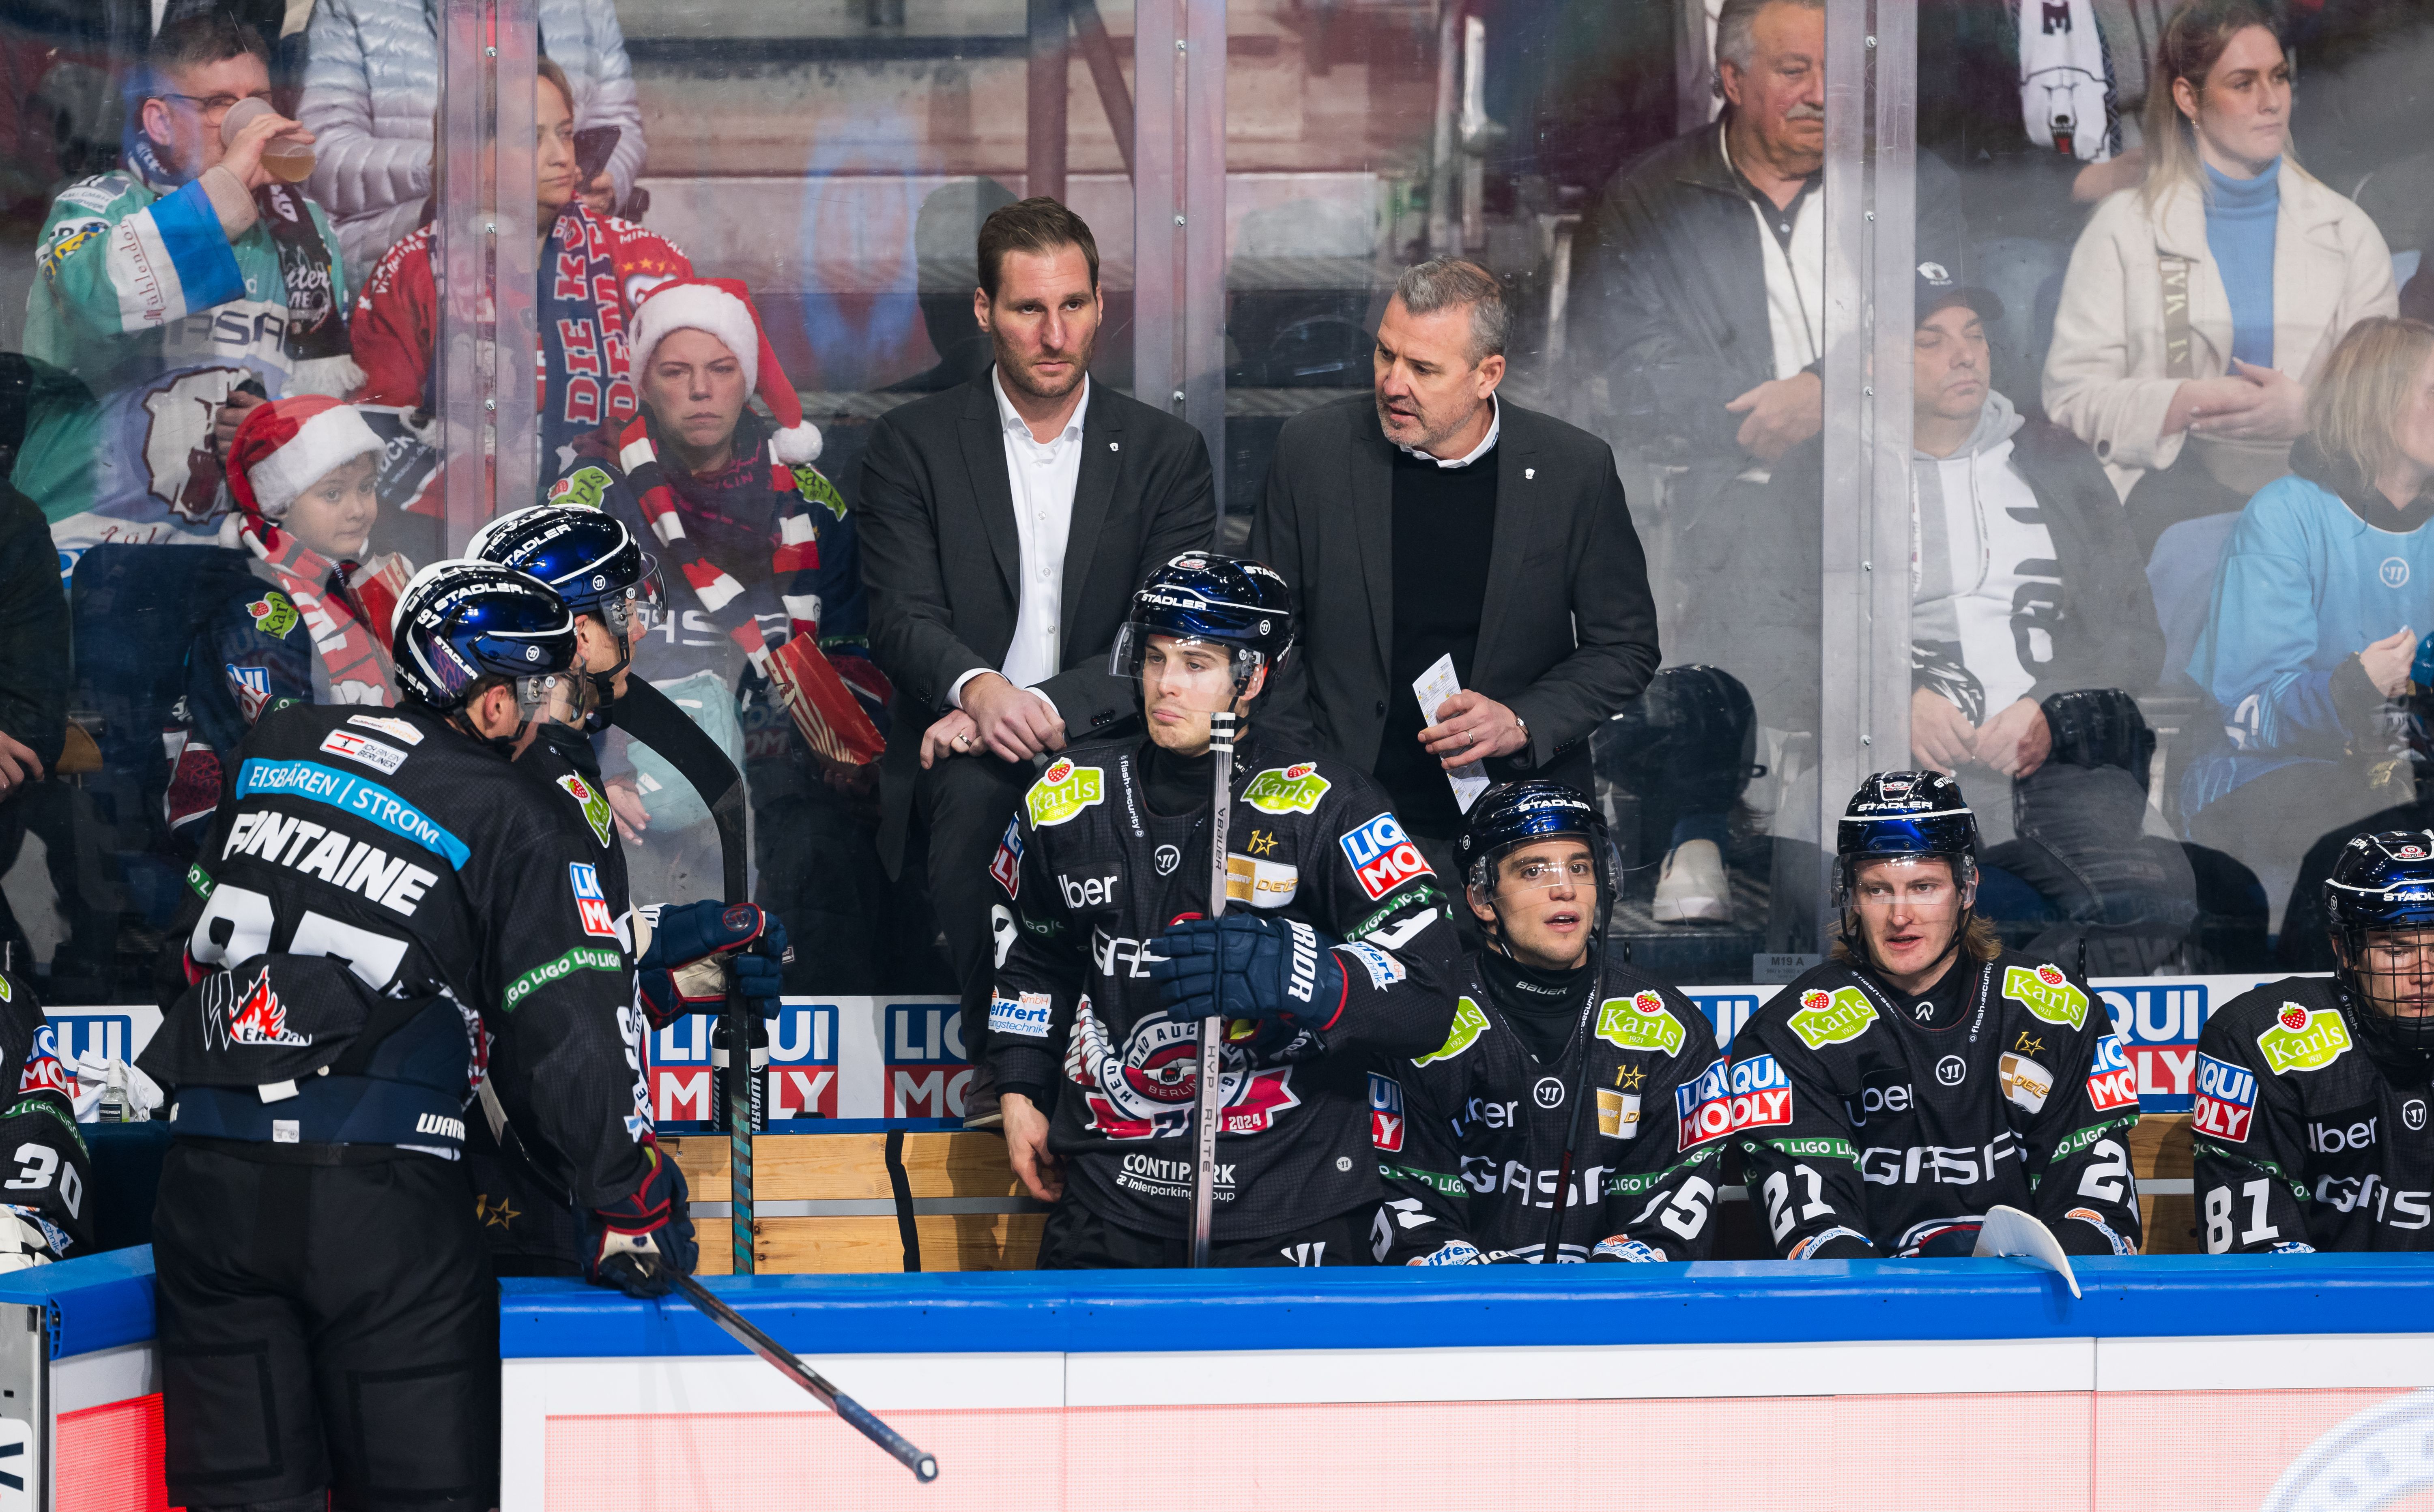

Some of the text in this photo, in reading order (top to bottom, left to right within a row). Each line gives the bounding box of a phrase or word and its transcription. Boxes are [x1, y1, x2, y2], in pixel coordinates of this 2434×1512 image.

[434, 582, 523, 611] STADLER
[1141, 593, 1206, 611] STADLER
[416, 608, 442, 629] 97
[433, 635, 478, 680] STADLER
[357, 750, 396, 769] BERLINER
[248, 762, 340, 802] EISBÄREN
[353, 788, 440, 845] STROM
[1032, 778, 1095, 820] Karls
[1250, 778, 1315, 805] Karls
[1518, 799, 1591, 812] STADLER
[1857, 801, 1933, 811] STADLER
[221, 810, 439, 917] FNTAINE
[531, 958, 570, 985] LIGO
[1771, 956, 1804, 966] M19 A
[2011, 973, 2082, 1022] Karls
[2037, 1005, 2053, 1017] 1921
[990, 1002, 1047, 1022] eiffert
[1799, 999, 1871, 1041] Karls
[1601, 1008, 1677, 1047] Karls
[1629, 1035, 1644, 1044] 1921
[1841, 1024, 1856, 1035] 1921
[1449, 1035, 1464, 1048] 1921
[2267, 1023, 2345, 1066] Karls
[1228, 1113, 1262, 1131] 2024
[1791, 1141, 1830, 1153] LIGO
[4, 1142, 82, 1220] 30
[1763, 1164, 1836, 1249] 21
[2205, 1177, 2279, 1255] 81
